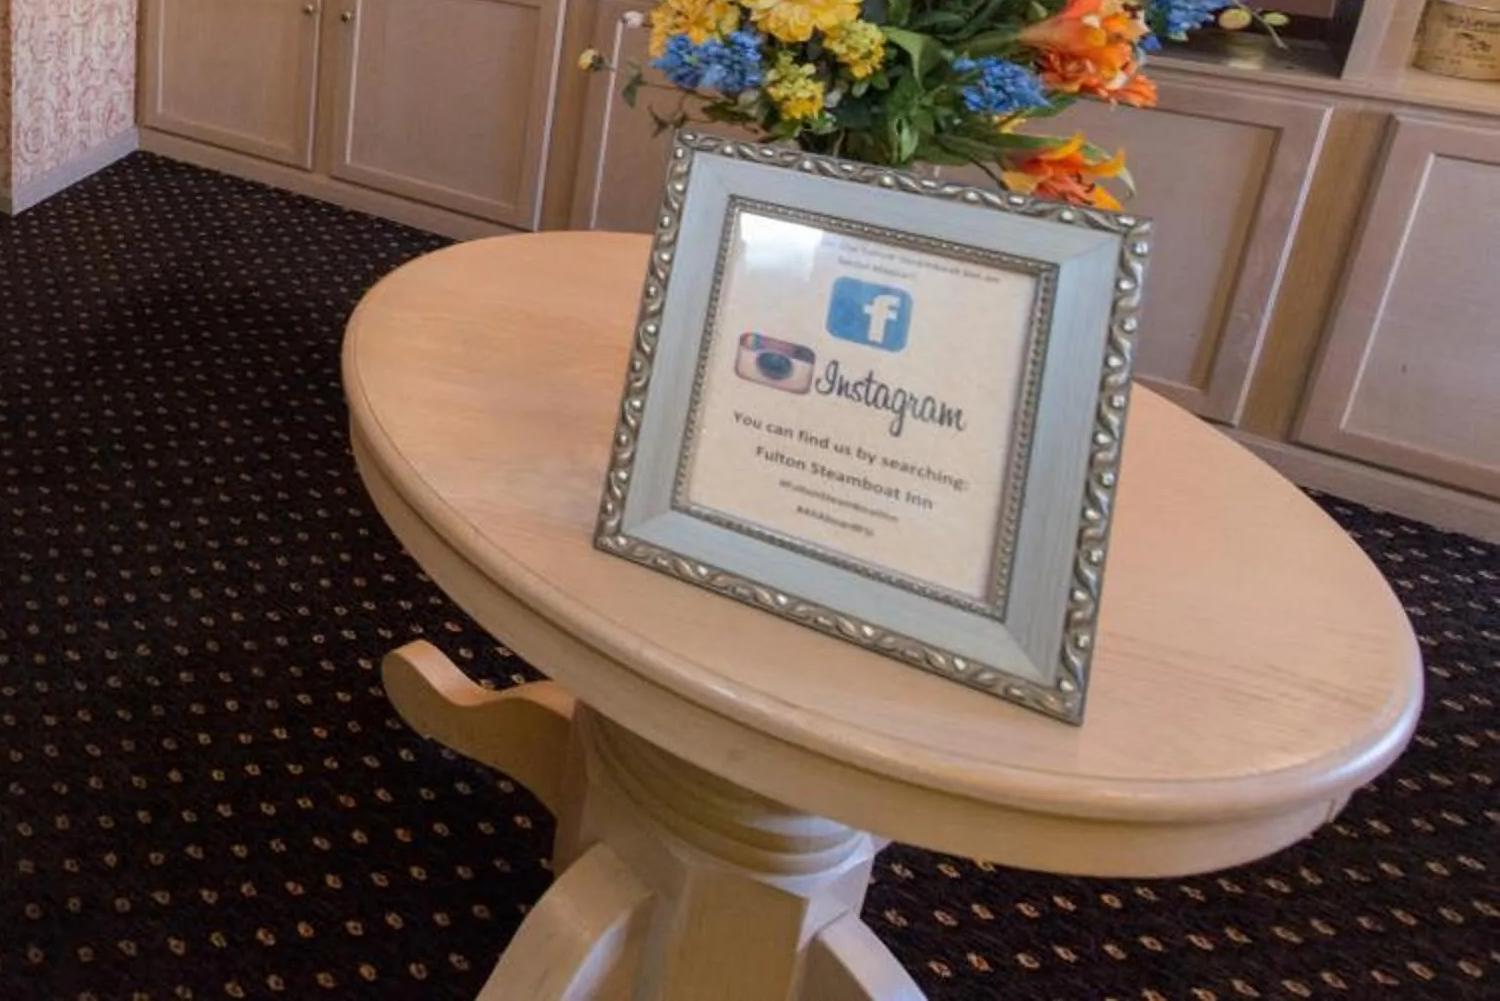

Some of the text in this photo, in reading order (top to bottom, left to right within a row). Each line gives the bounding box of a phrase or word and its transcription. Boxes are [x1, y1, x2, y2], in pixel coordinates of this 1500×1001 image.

[815, 360, 966, 437] Instagram
[733, 412, 762, 432] You
[766, 422, 793, 440] can
[798, 427, 830, 450] find
[833, 443, 852, 457] us
[856, 447, 877, 467] by
[755, 445, 934, 510] Fulton Steamboat Inn
